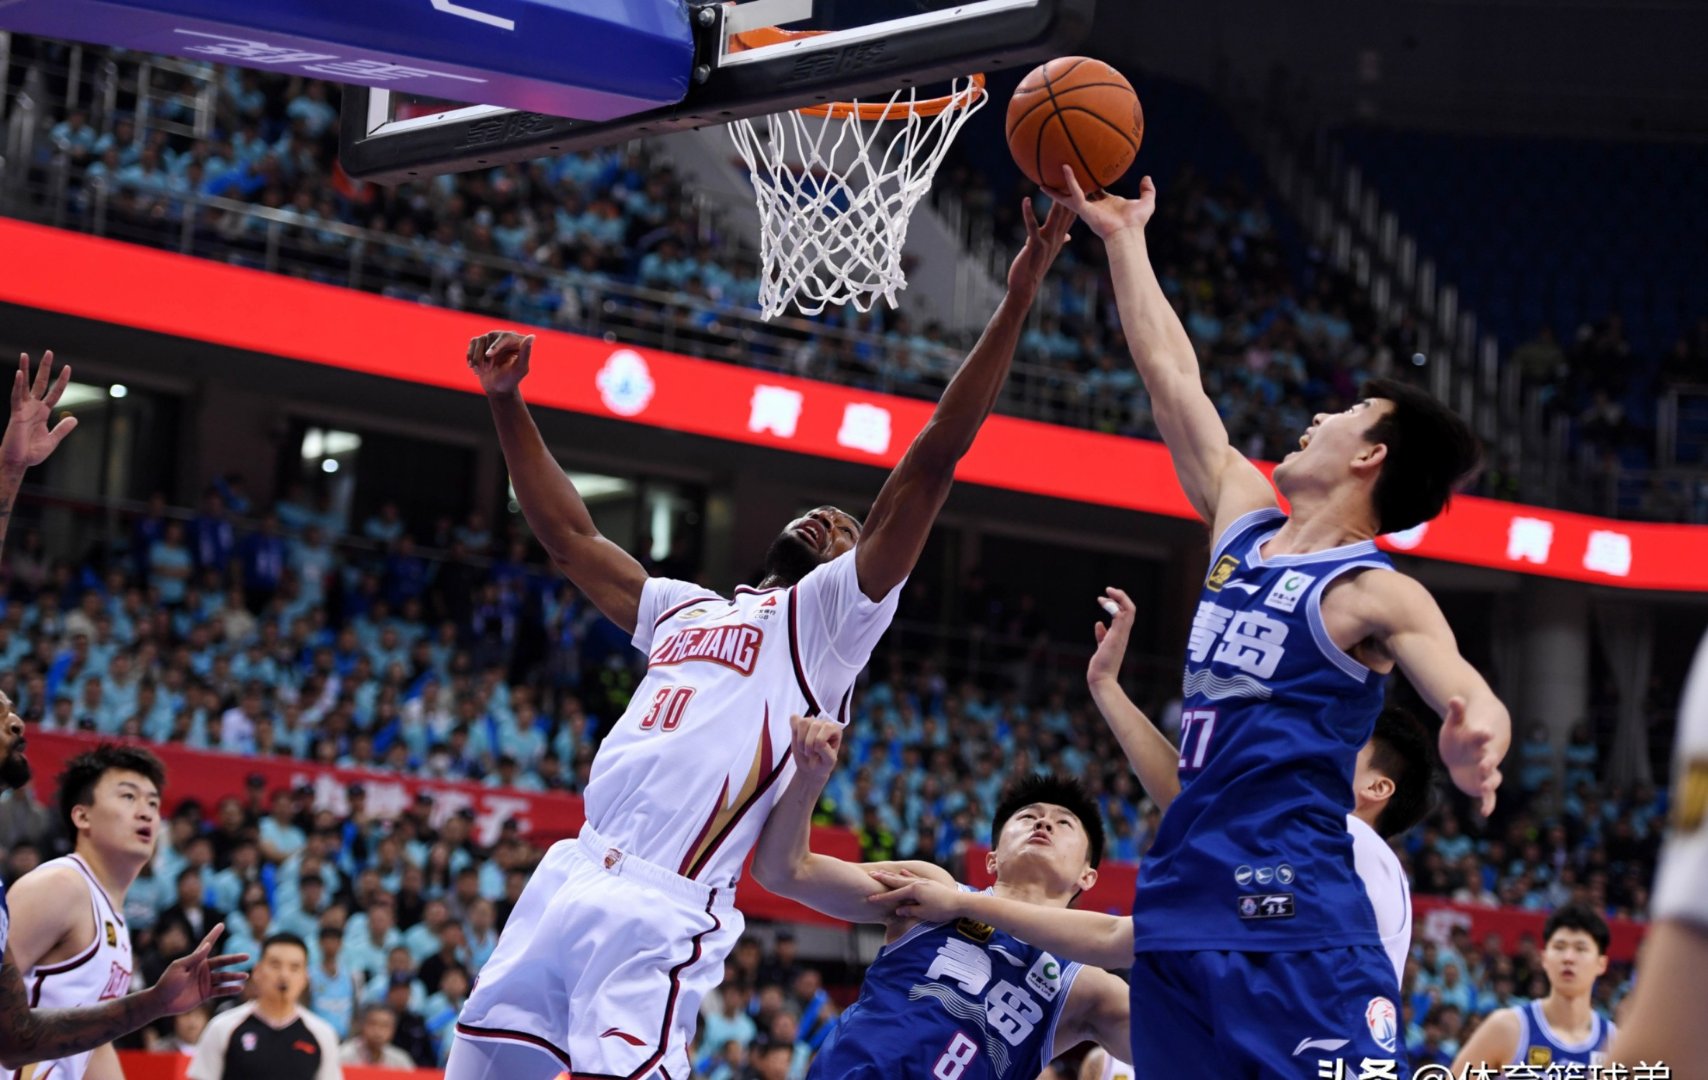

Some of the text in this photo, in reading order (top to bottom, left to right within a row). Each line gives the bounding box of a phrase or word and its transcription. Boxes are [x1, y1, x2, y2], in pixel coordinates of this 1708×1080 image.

[649, 625, 761, 675] ZHEJIANG
[1187, 600, 1290, 680] 青岛
[640, 686, 697, 732] 30
[1178, 709, 1217, 769] 27
[924, 936, 1044, 1047] 青岛
[933, 1031, 979, 1080] 8
